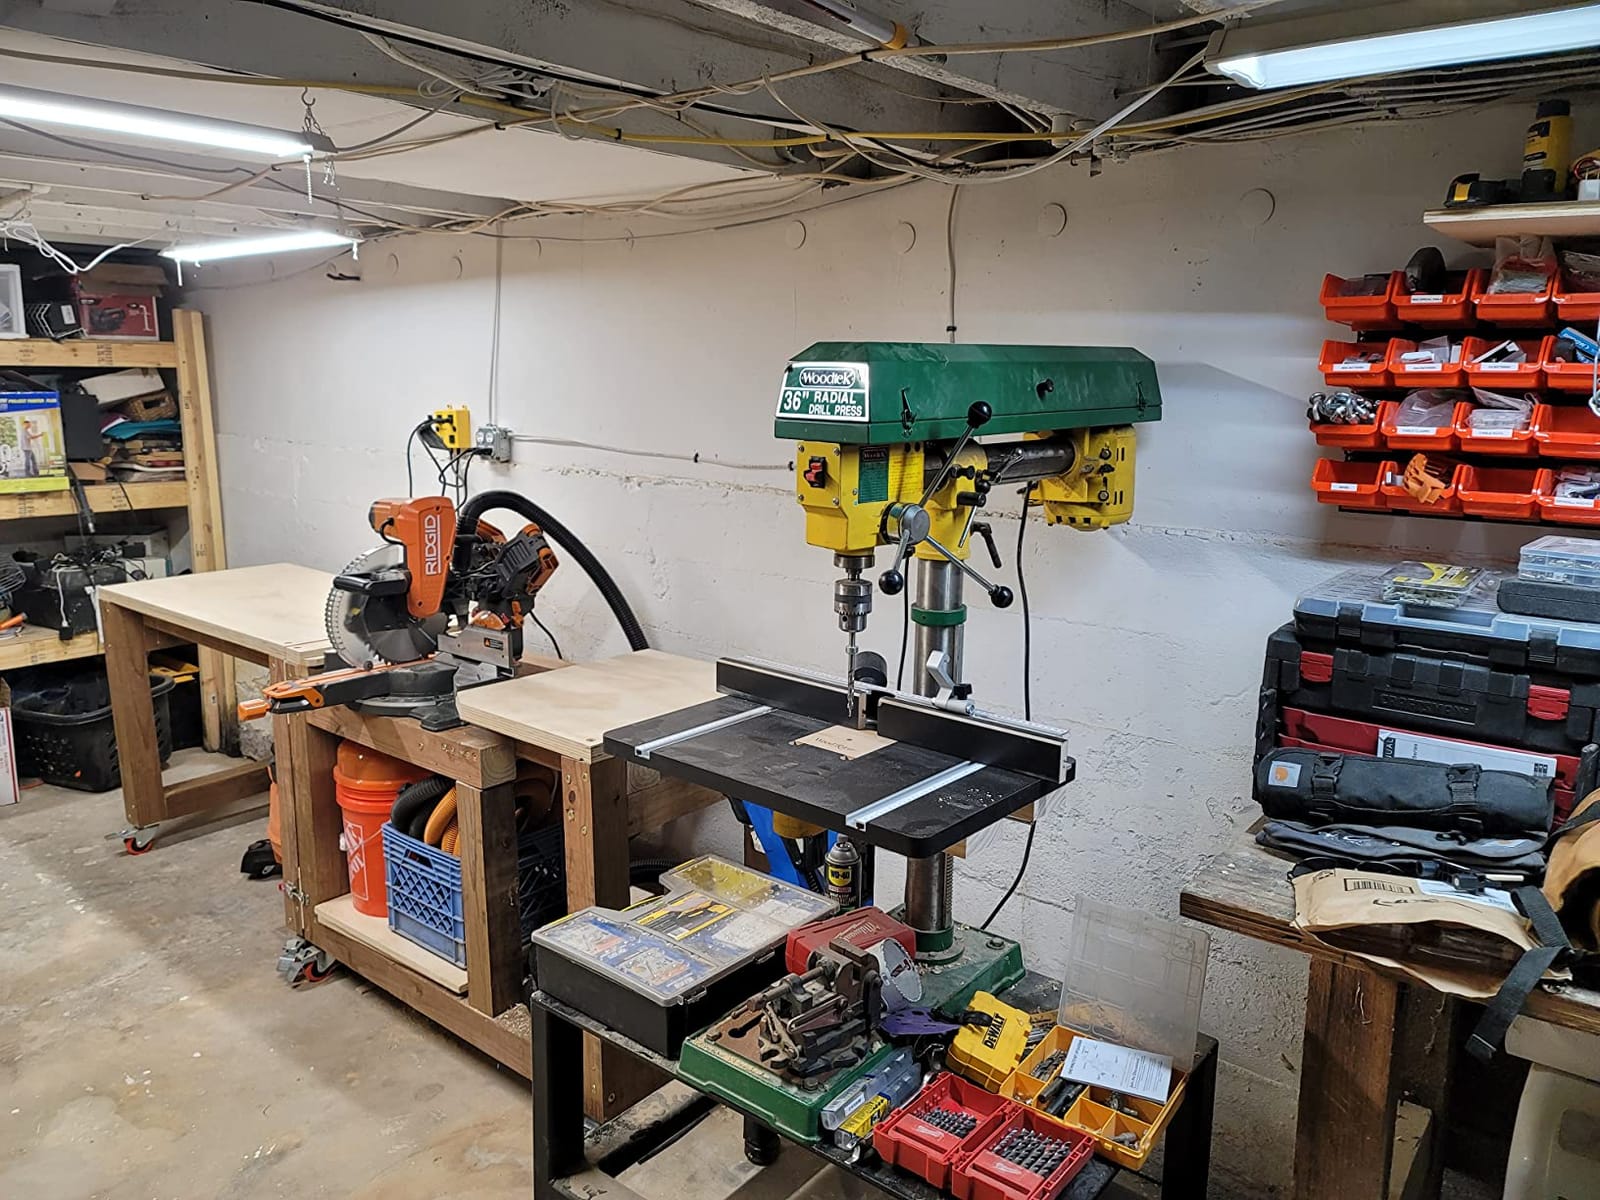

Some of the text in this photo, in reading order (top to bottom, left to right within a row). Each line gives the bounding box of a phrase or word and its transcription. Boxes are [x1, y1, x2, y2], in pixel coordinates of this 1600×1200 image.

[803, 372, 852, 385] Woodtek
[784, 391, 857, 410] 36" RADIAL
[808, 404, 863, 416] DRILL PRESS
[424, 515, 437, 575] RIDGID
[831, 871, 849, 879] WD-40
